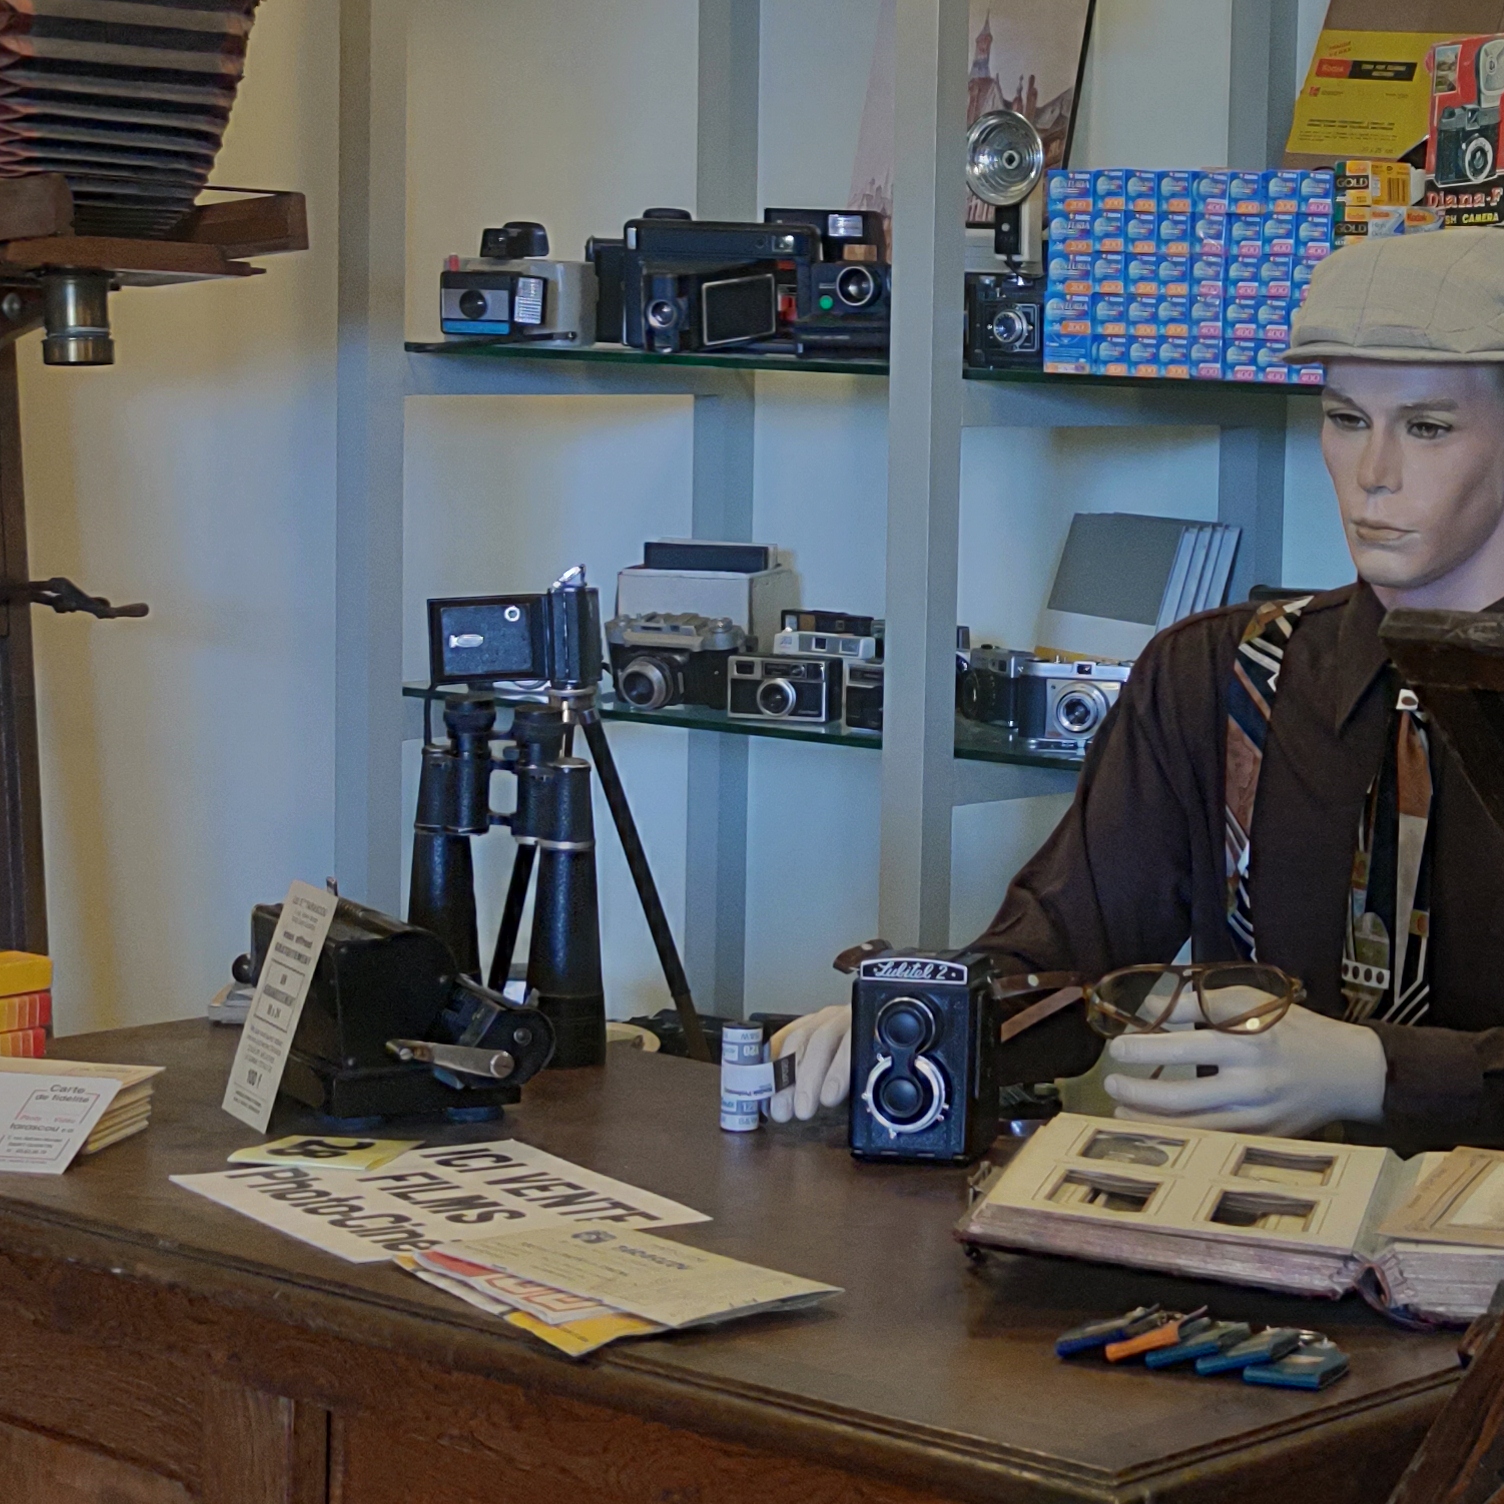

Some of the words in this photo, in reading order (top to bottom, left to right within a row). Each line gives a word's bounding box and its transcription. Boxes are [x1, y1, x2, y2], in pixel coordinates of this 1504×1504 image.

[1336, 177, 1369, 189] GOLD
[1426, 186, 1504, 210] Diana-F
[1206, 202, 1225, 212] 400
[1309, 203, 1329, 213] 400
[1461, 212, 1500, 225] CAMERA
[1335, 222, 1368, 234] GOLD
[1240, 246, 1260, 255] 400
[1273, 244, 1291, 254] 400
[1308, 246, 1327, 256] 400
[1238, 286, 1257, 295] 400
[1270, 285, 1289, 295] 400
[1201, 326, 1220, 335] 400
[1235, 328, 1254, 338] 400
[1267, 329, 1286, 338] 400
[1200, 367, 1219, 377] 400
[1235, 370, 1254, 379] 400
[1267, 372, 1286, 381] 400
[1302, 373, 1321, 383] 400
[872, 960, 932, 980] Lubitel
[935, 965, 948, 980] 2
[49, 1084, 86, 1095] Carte
[419, 1147, 515, 1175] ICI
[484, 1170, 664, 1224] VENTE
[358, 1171, 528, 1227] FILMS
